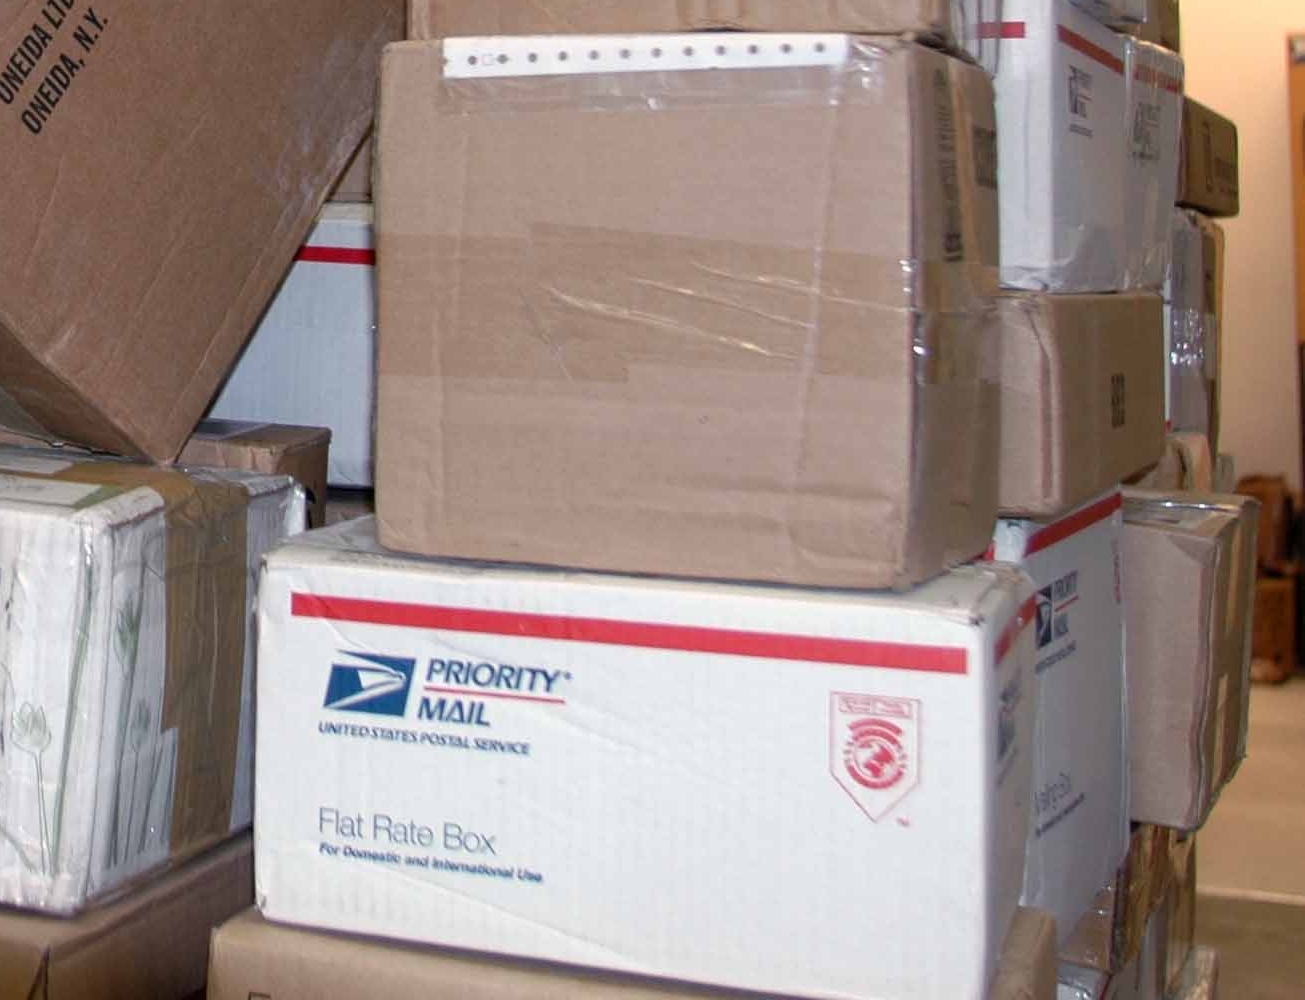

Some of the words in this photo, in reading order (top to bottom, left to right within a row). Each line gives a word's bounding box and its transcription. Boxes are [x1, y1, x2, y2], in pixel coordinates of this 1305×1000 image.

[21, 53, 86, 135] ONEIDA,
[73, 7, 109, 53] N.Y.
[425, 657, 562, 693] PRIORITY
[417, 696, 491, 727] MAIL
[318, 720, 371, 738] UNITED
[369, 725, 419, 745] STATES
[420, 731, 471, 750] POSTAL
[473, 737, 531, 756] SERVICE
[319, 806, 365, 840] Flat
[373, 812, 435, 849] Rate
[443, 821, 498, 856] Box
[319, 842, 341, 857] For
[343, 845, 402, 865] Domestic
[405, 855, 430, 868] and
[432, 857, 515, 879] International
[517, 867, 543, 883] Use
